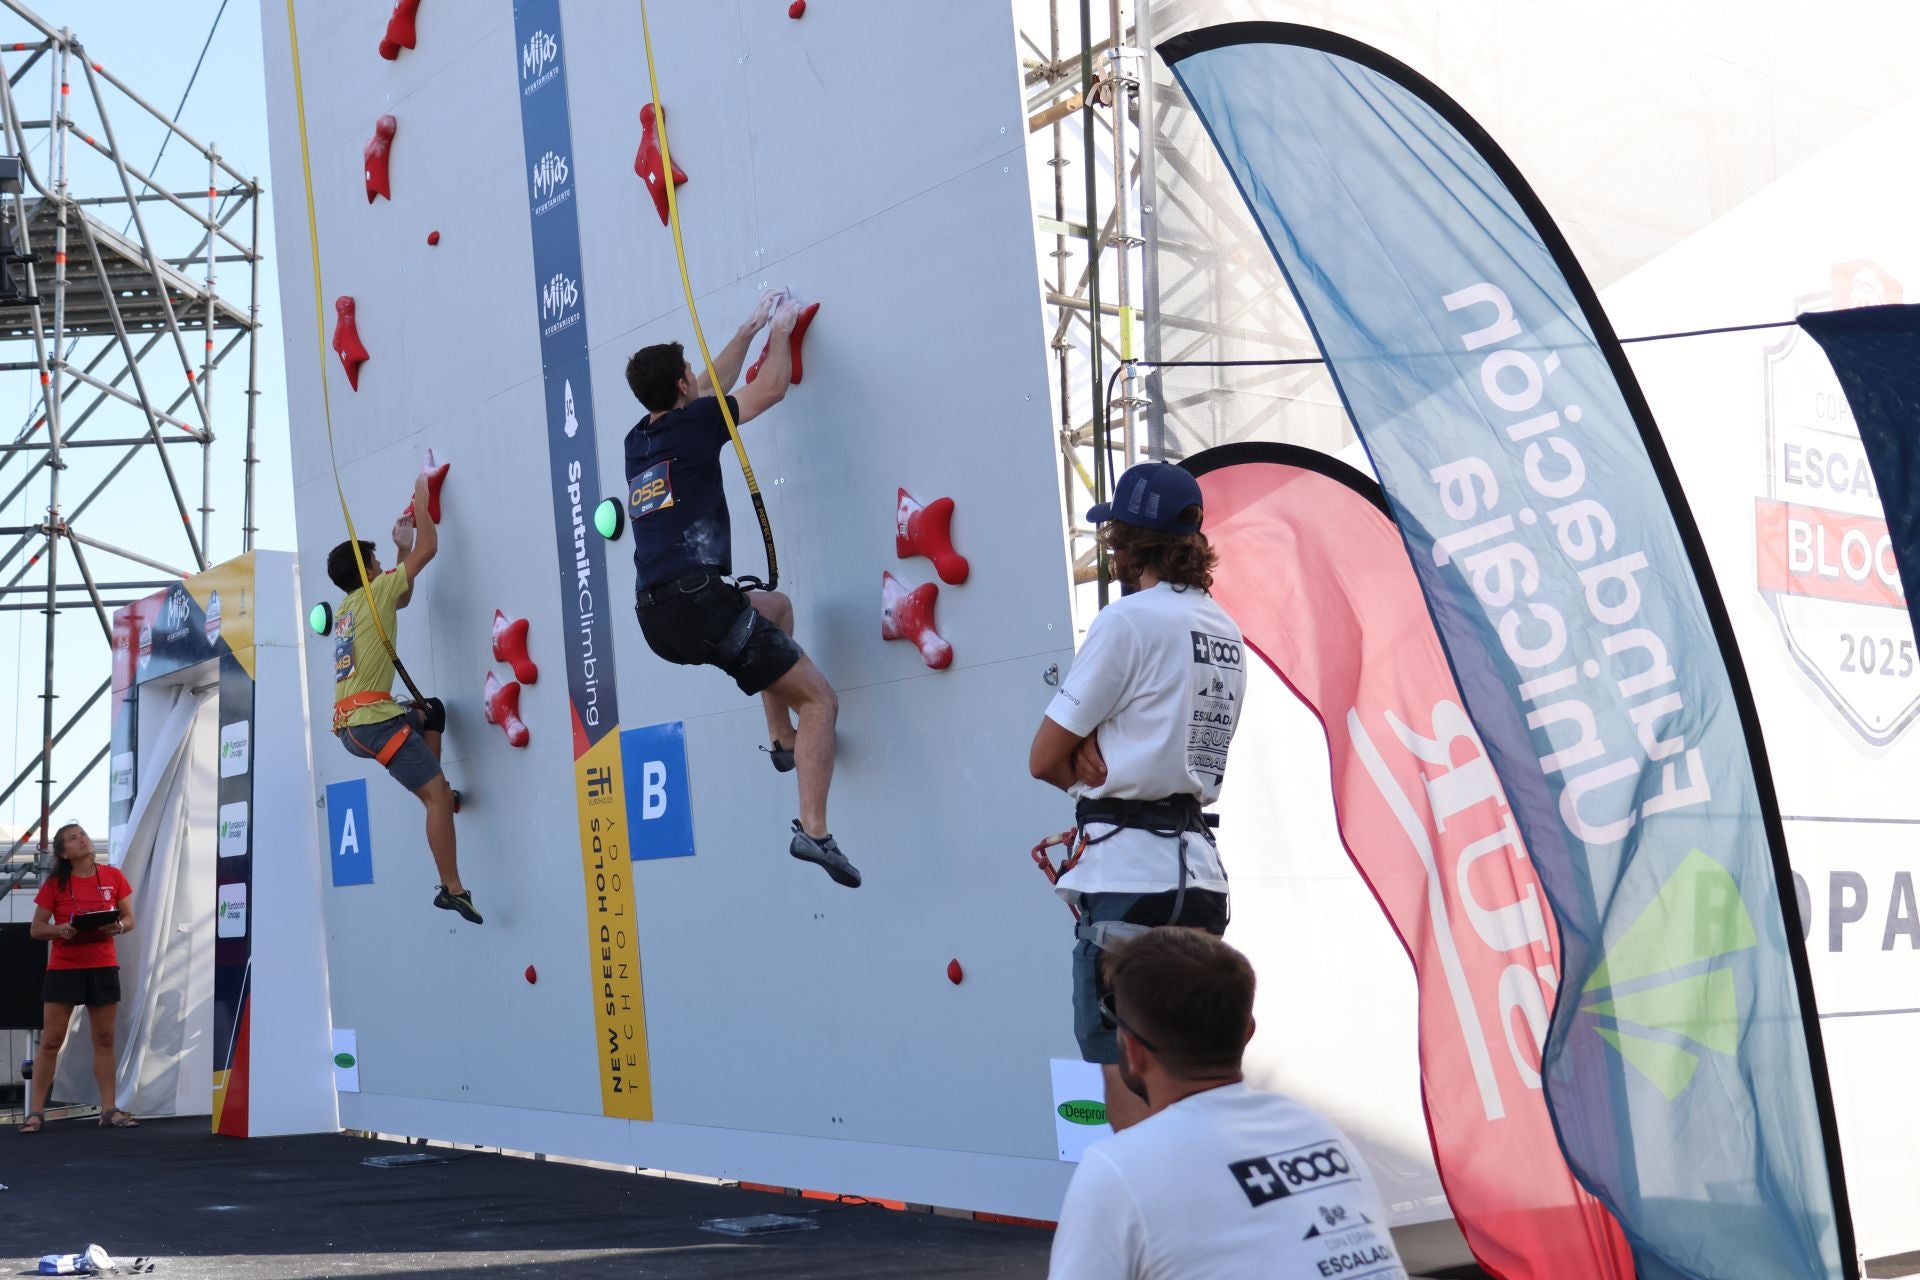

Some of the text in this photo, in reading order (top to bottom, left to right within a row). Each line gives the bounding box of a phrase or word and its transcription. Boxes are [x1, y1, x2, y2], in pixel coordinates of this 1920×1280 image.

[523, 29, 557, 79] Mijas
[533, 150, 568, 199] Mijas
[543, 272, 578, 320] Mijas
[1815, 392, 1852, 422] COP
[632, 478, 666, 506] 052
[1784, 443, 1881, 499] ESCA
[1840, 633, 1914, 679] 2025
[643, 760, 668, 820] B
[340, 808, 359, 855] A
[590, 817, 622, 1093] NEW SPEED HOLDS
[606, 817, 639, 1093] TECHNOLOGY
